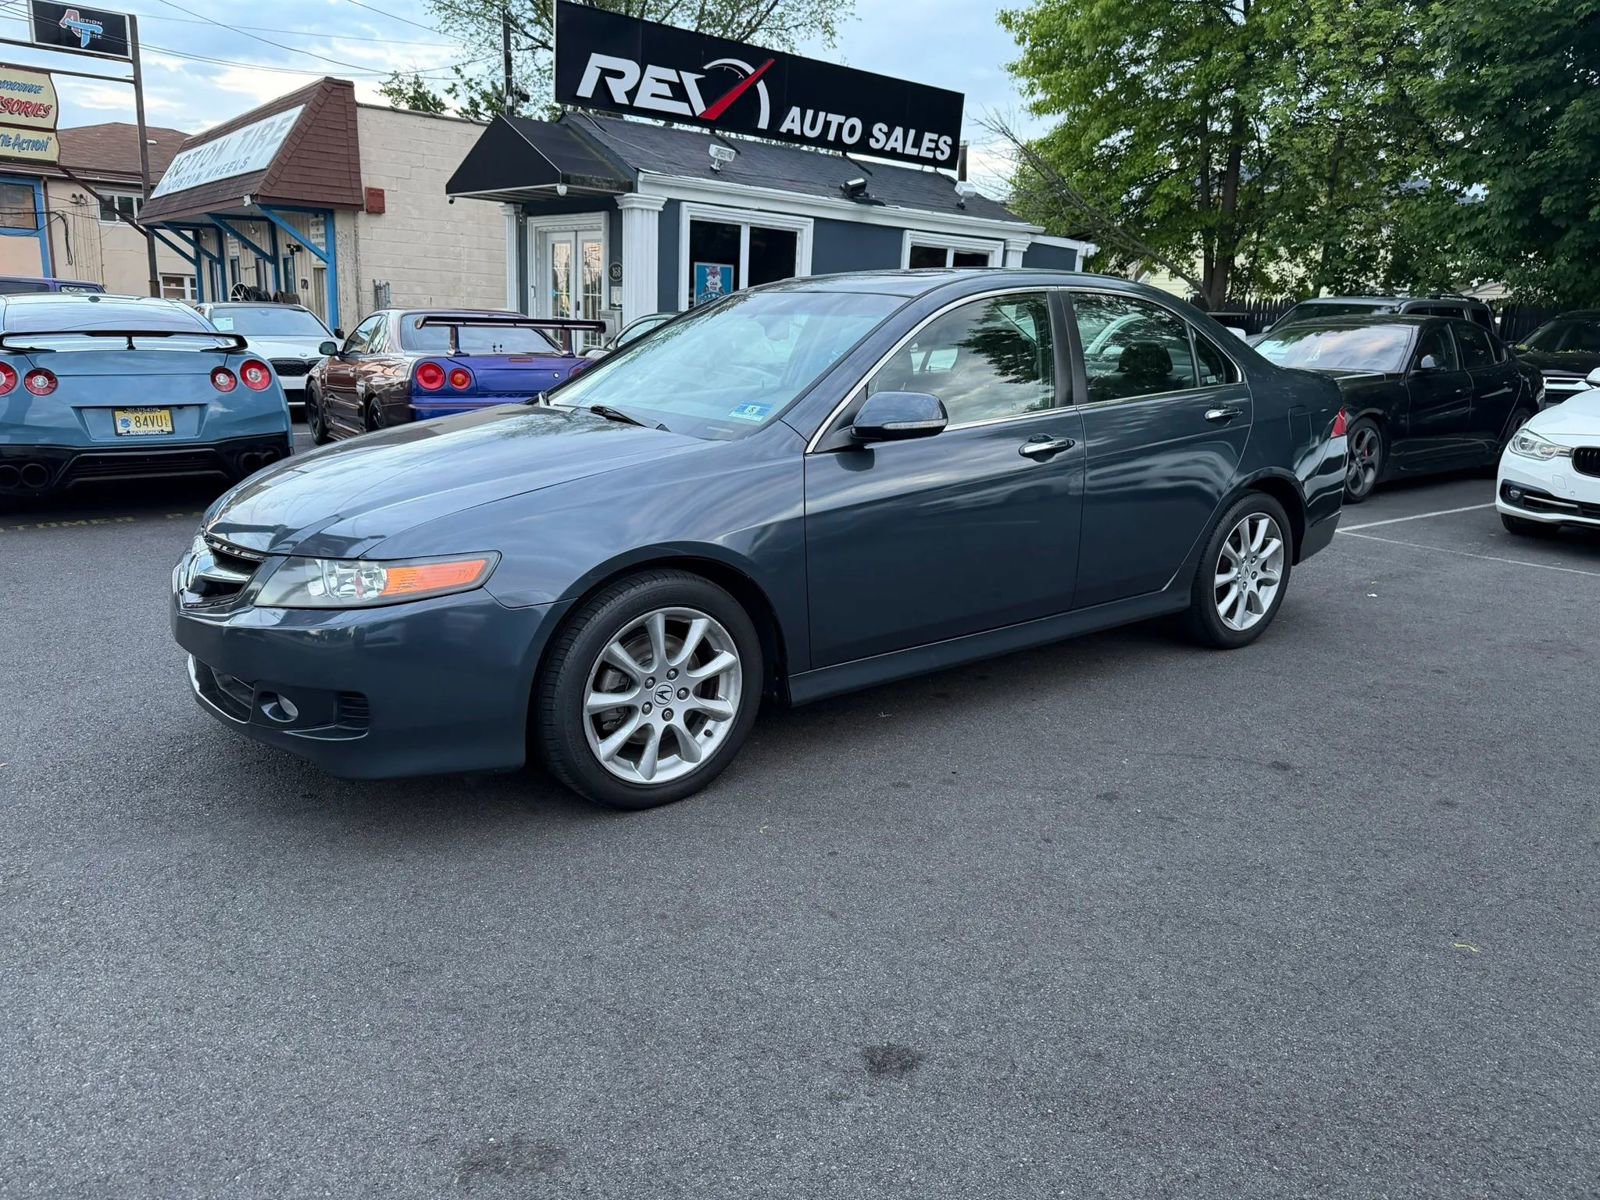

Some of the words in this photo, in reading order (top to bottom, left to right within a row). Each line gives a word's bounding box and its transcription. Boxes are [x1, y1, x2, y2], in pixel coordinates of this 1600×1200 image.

[576, 52, 775, 121] REV
[167, 138, 232, 179] ACTION
[235, 114, 295, 159] TIRE
[779, 106, 862, 145] AUTO
[869, 123, 952, 161] SALES
[205, 156, 250, 179] WHEELS
